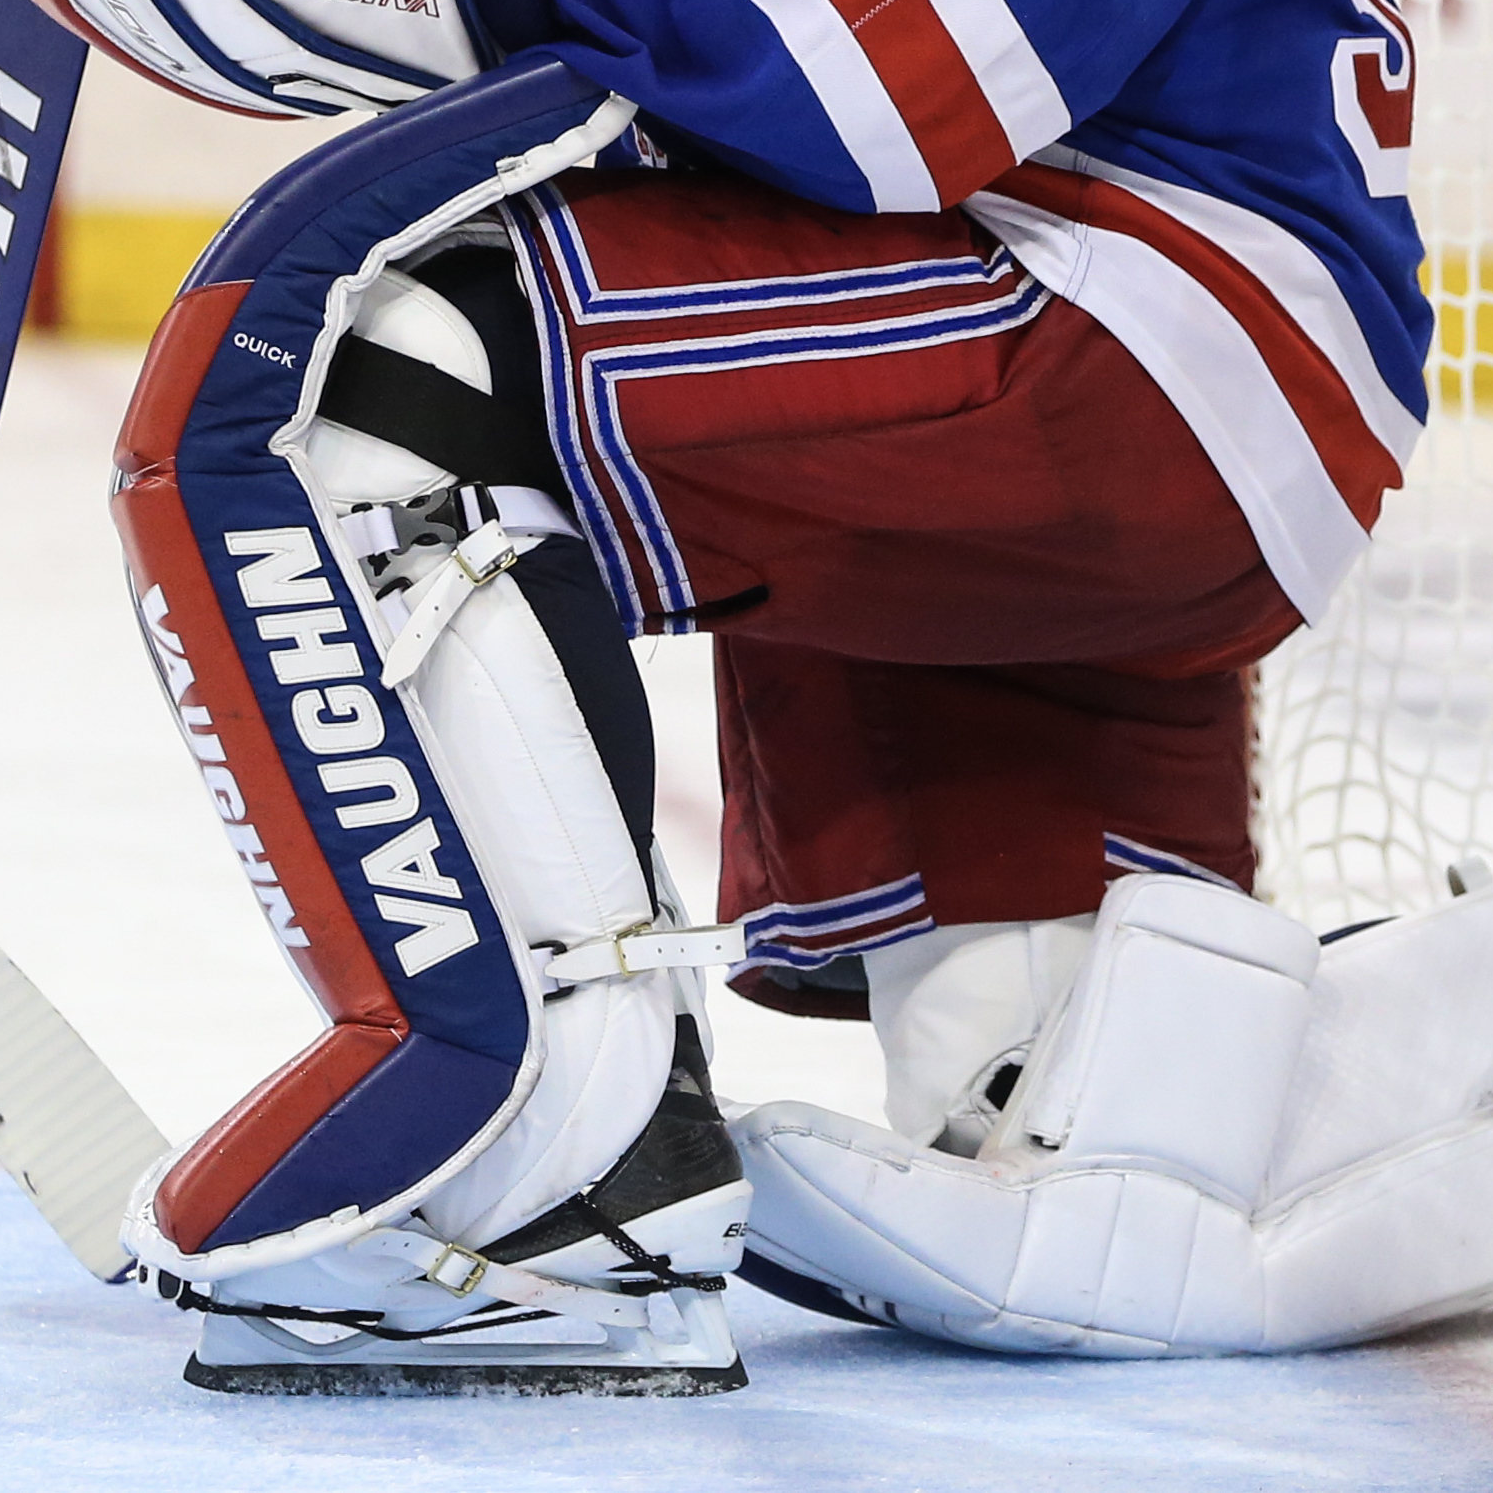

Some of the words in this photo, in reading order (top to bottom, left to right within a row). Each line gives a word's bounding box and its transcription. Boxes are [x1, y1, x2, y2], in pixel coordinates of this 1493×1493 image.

[234, 332, 297, 369] QUICK
[142, 583, 311, 949] VAUGHN
[223, 527, 481, 978] VAUGHN
